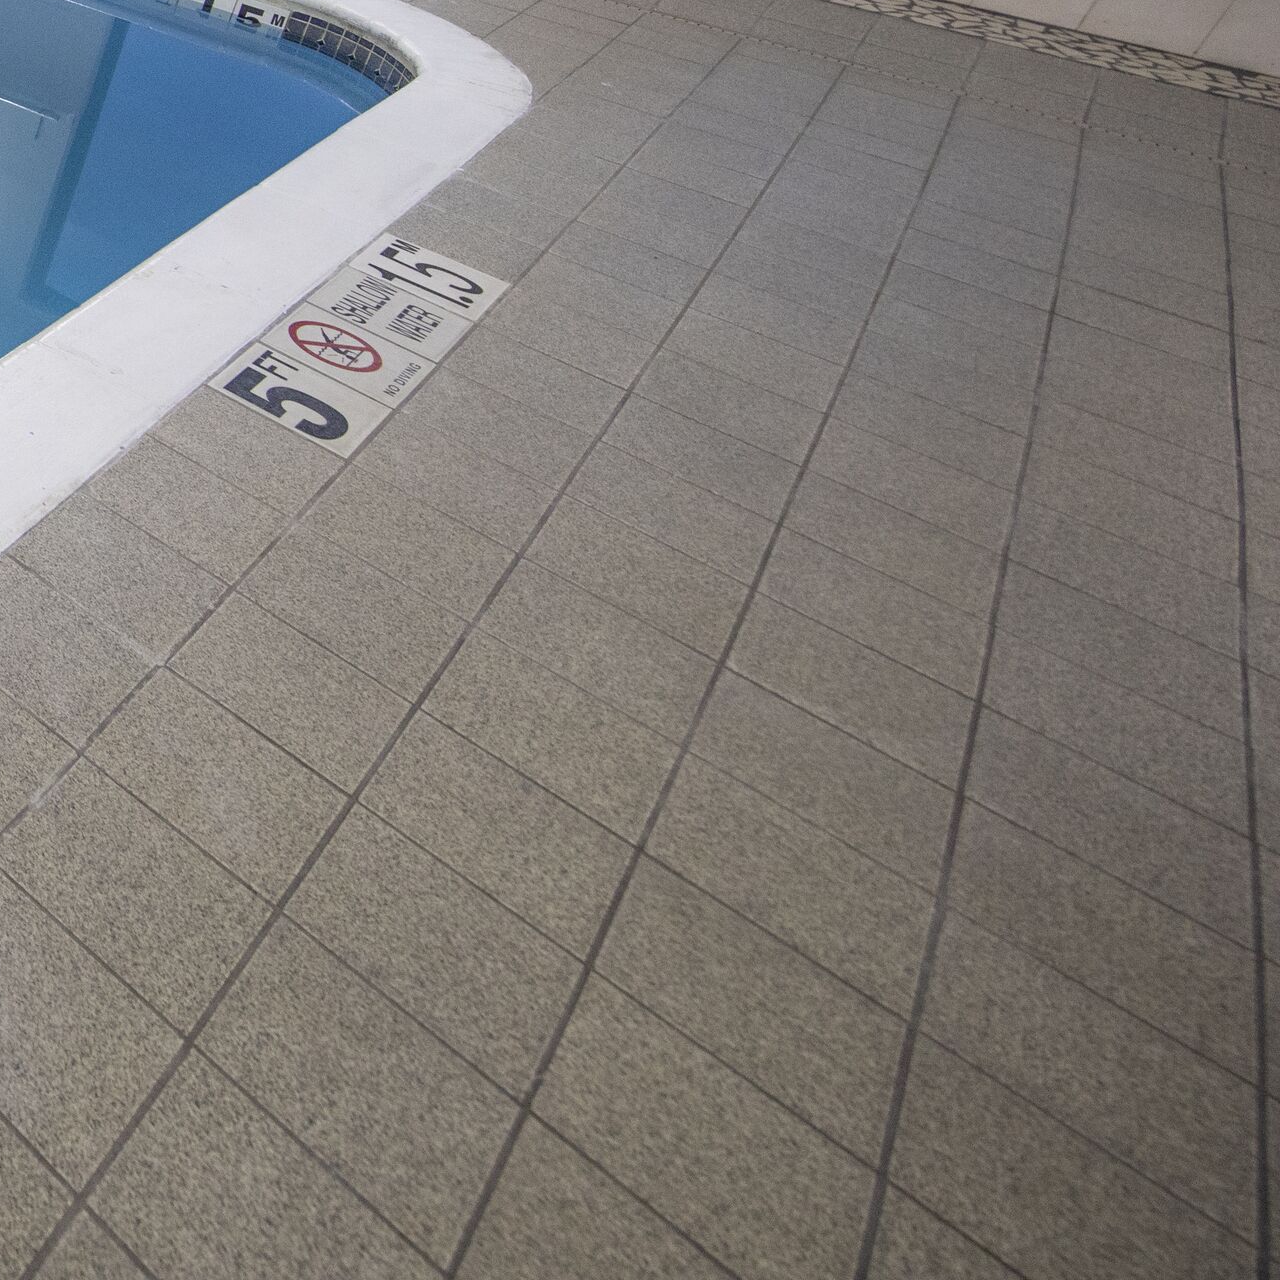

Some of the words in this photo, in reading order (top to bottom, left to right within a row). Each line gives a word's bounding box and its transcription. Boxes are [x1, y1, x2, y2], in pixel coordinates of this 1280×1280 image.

[331, 276, 397, 324] SHALLOW
[386, 304, 444, 343] WATER
[383, 384, 401, 397] NO
[398, 362, 422, 388] DIVING
